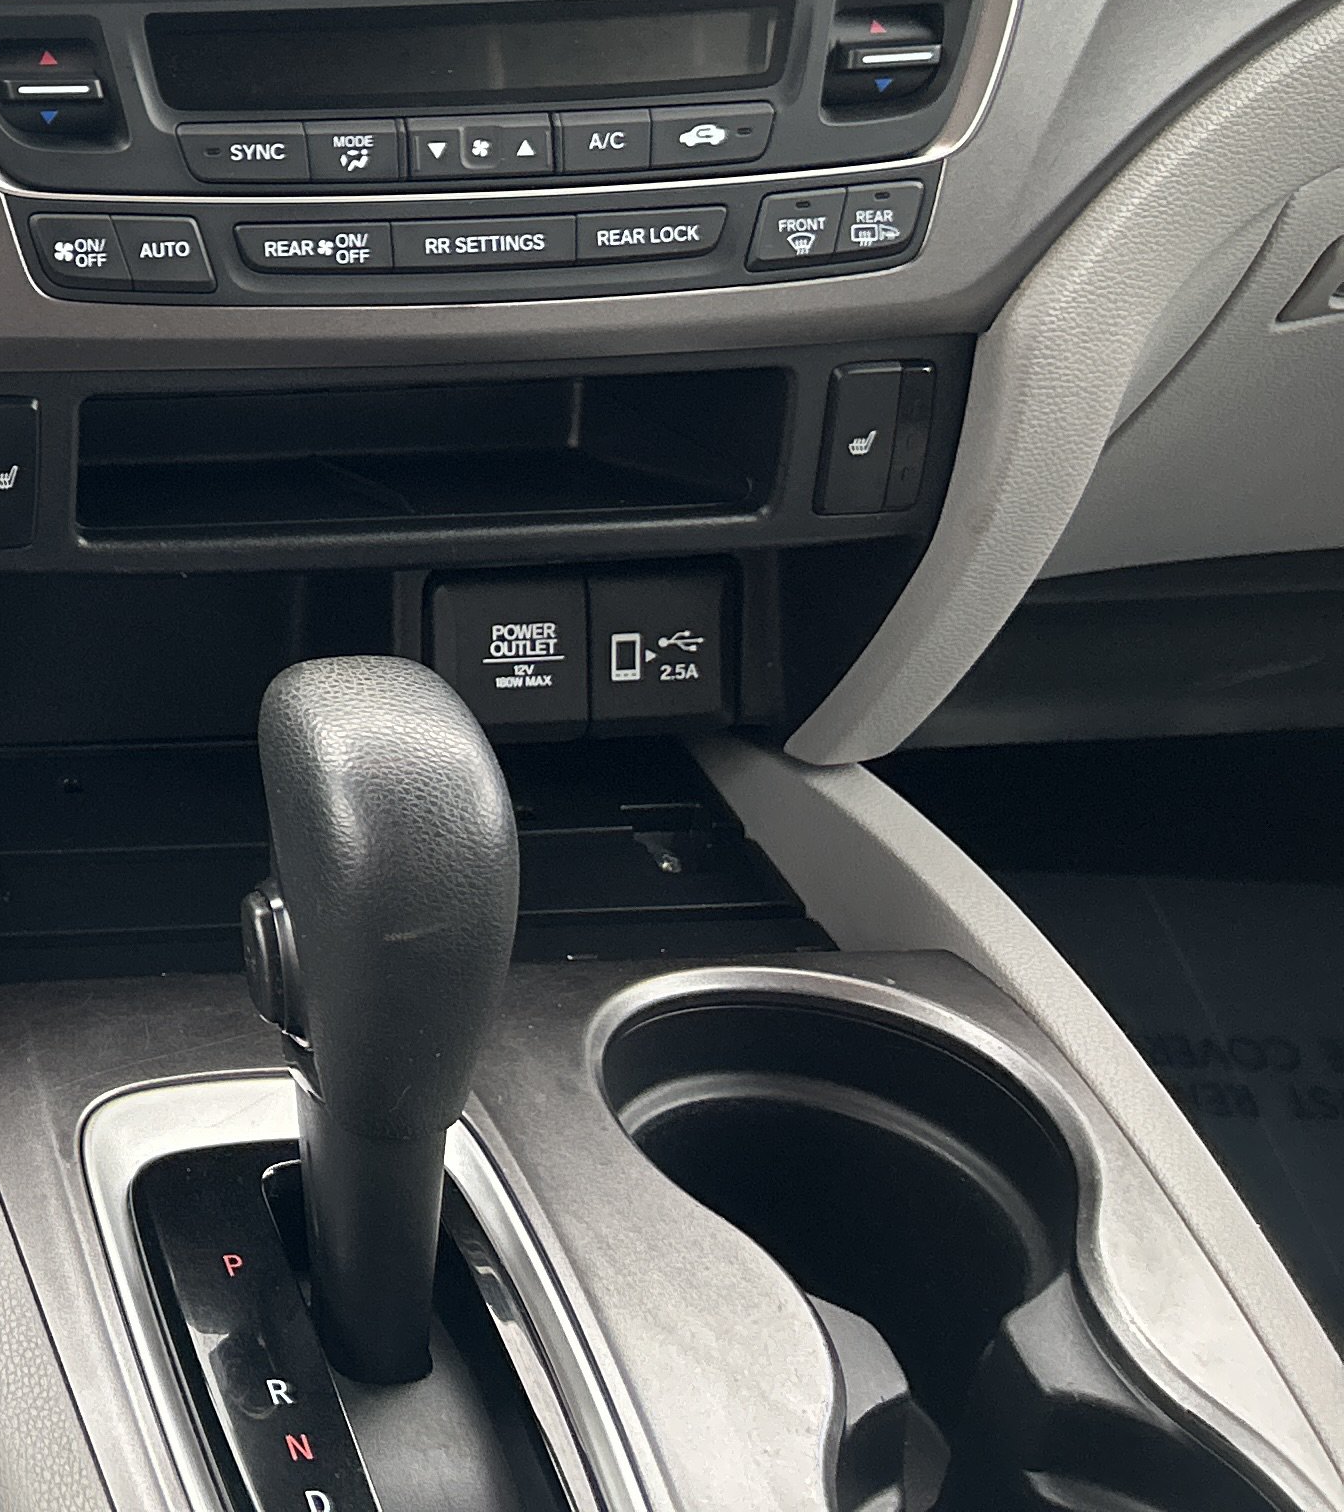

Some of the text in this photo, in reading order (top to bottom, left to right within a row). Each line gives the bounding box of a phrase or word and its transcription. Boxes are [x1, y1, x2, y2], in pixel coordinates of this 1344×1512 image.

[332, 135, 374, 149] MODE
[588, 131, 626, 151] A/C
[229, 142, 286, 162] SYNC
[777, 216, 826, 234] FRONT
[854, 209, 894, 224] REAR
[334, 233, 369, 250] ON/
[423, 233, 546, 255] RR SETTINGS
[597, 224, 700, 247] REAR LOCK
[74, 237, 107, 255] ON/
[138, 240, 191, 259] AUTO
[264, 240, 315, 257] REAR
[74, 253, 107, 270] OFF
[334, 248, 370, 265] OFF
[491, 622, 557, 641] POWER
[489, 639, 558, 658] OUTLET
[513, 664, 536, 676] 12V
[659, 663, 699, 682] 2.5A
[525, 674, 553, 688] MAX
[222, 1253, 244, 1277] P
[265, 1378, 295, 1405] R
[284, 1433, 315, 1461] N
[305, 1490, 332, 1512] D
